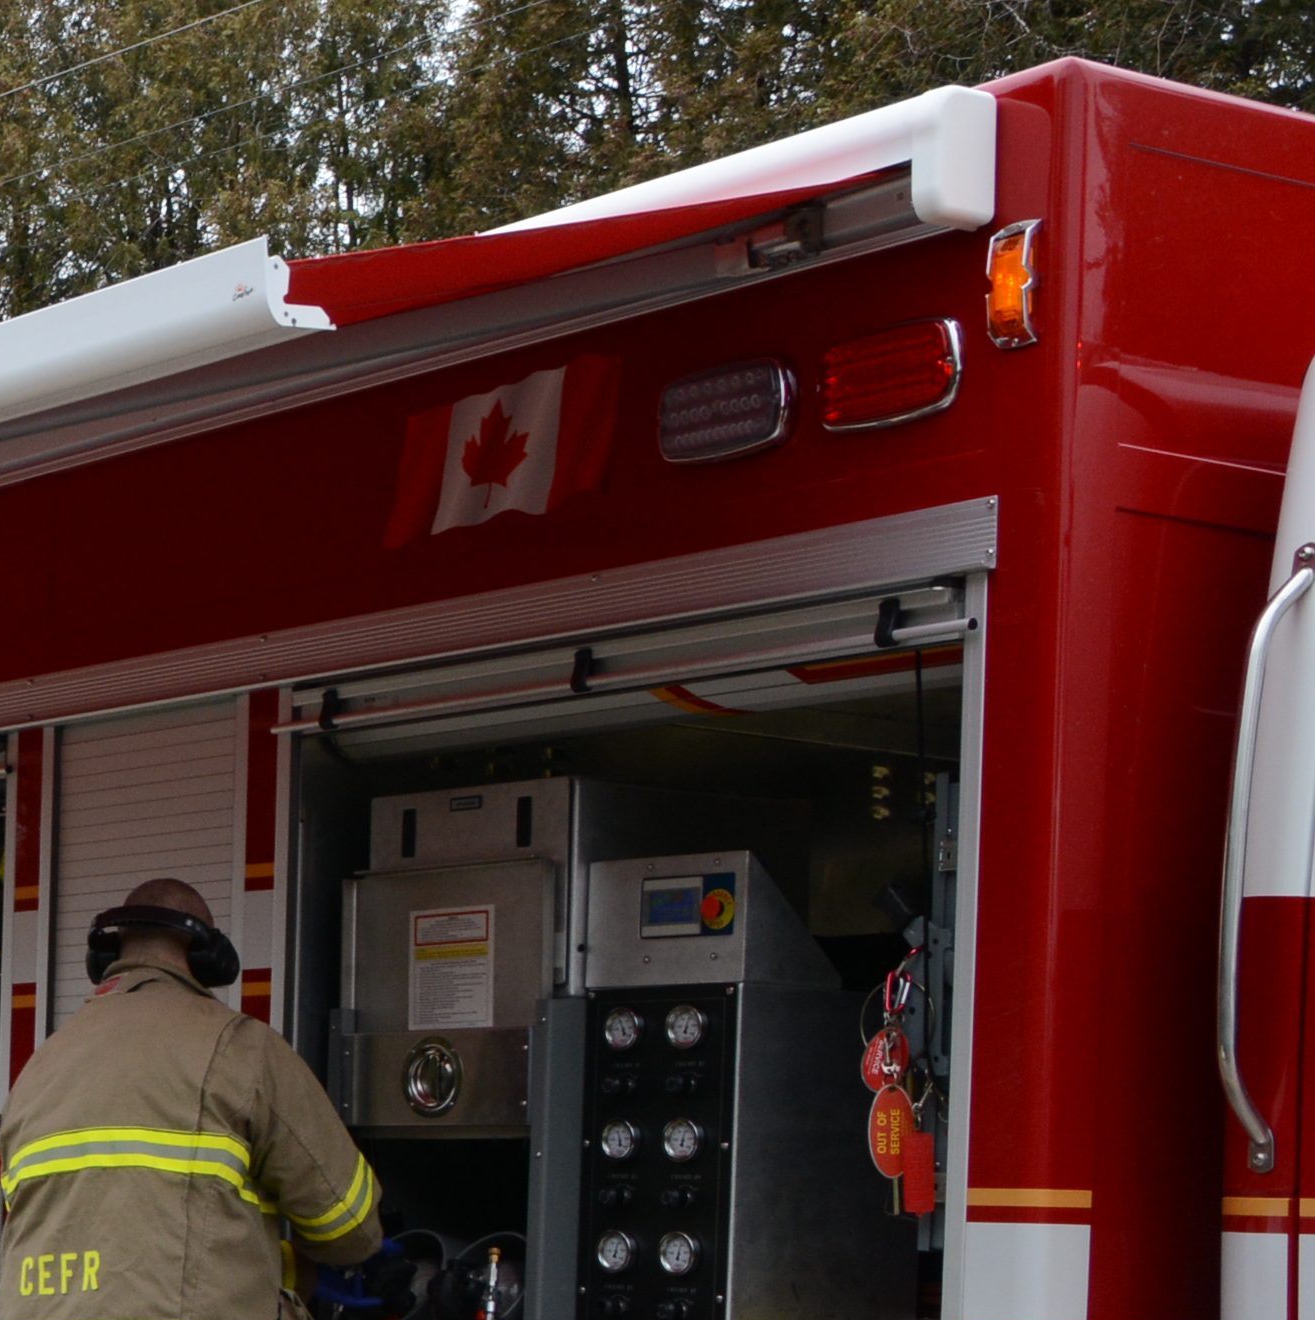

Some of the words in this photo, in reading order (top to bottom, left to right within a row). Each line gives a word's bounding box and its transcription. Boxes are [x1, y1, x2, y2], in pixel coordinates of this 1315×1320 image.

[876, 1111, 888, 1126] OF
[889, 1108, 901, 1156] SERVICE
[876, 1131, 888, 1155] OUT
[19, 1250, 101, 1297] CEFR
